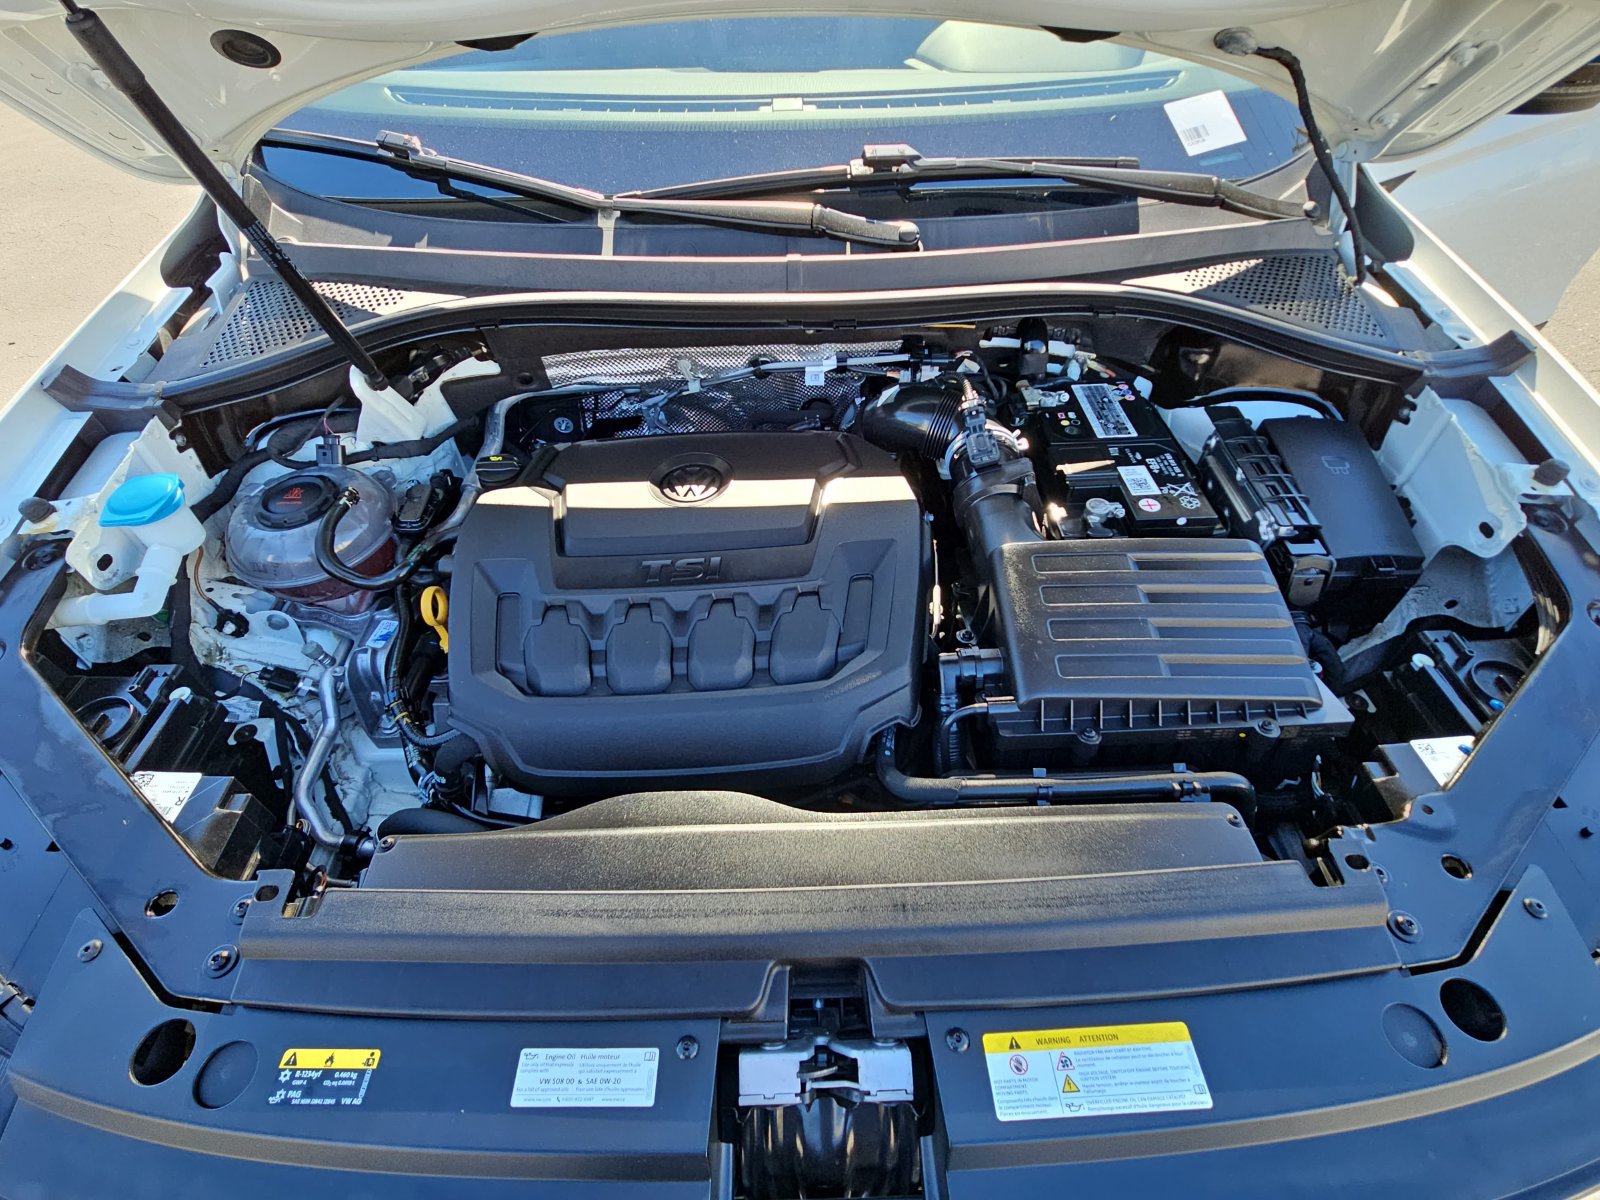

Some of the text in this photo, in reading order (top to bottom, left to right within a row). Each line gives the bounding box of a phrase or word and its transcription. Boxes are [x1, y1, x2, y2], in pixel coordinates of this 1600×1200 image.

[640, 556, 722, 583] TSI
[1036, 1034, 1119, 1046] WARNING ATTENTION
[545, 1054, 565, 1062] Engine
[294, 1070, 322, 1080] R-1234yf
